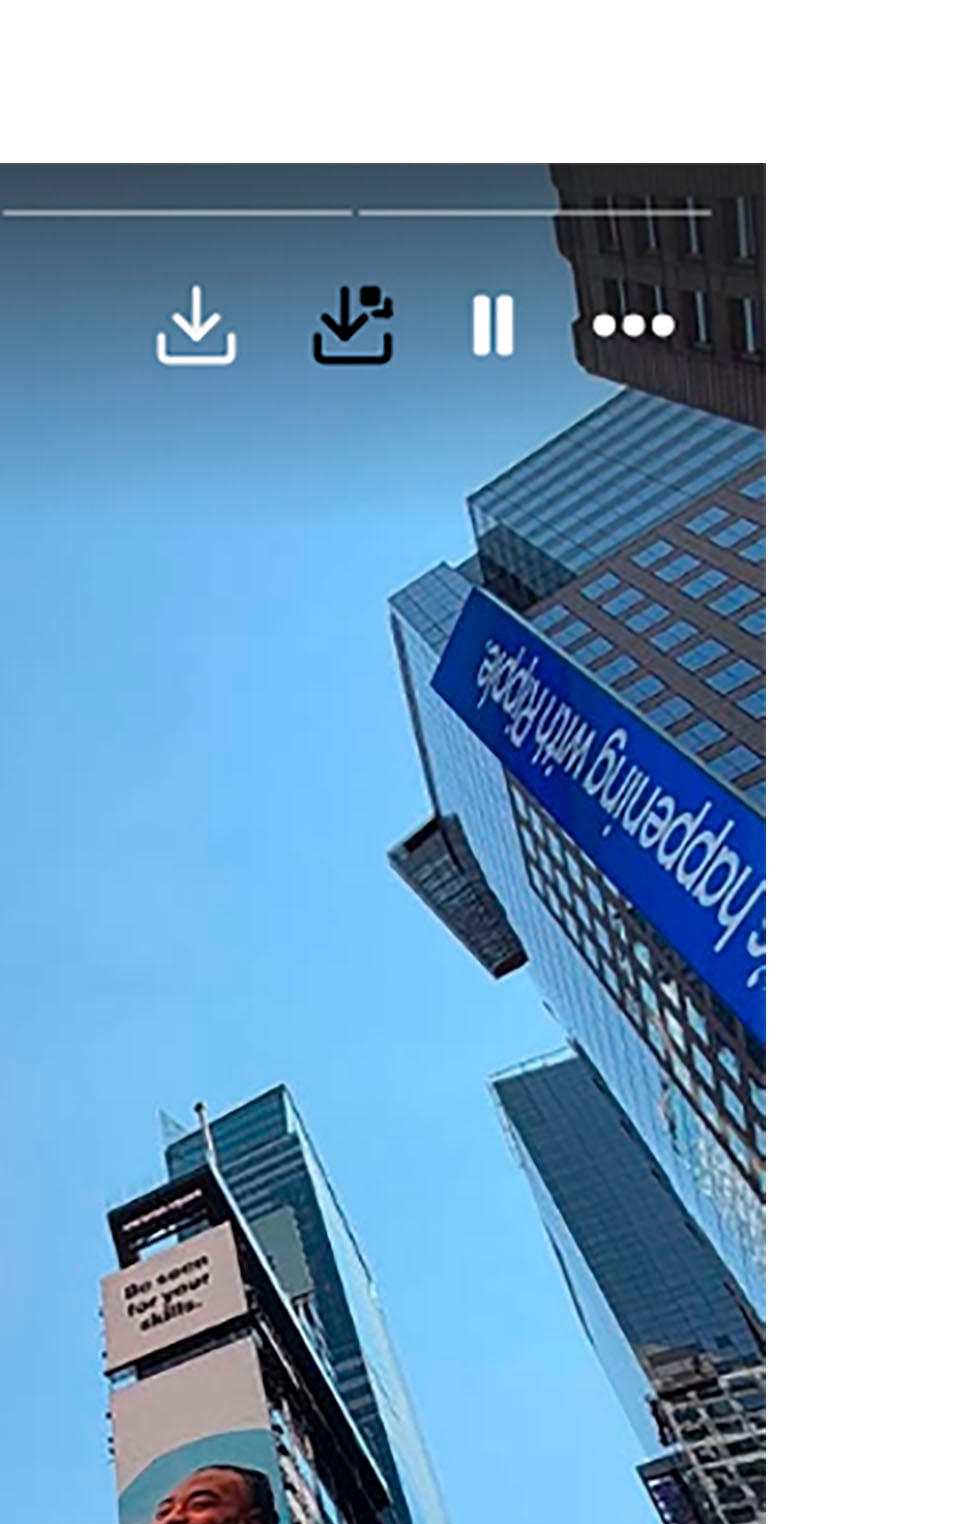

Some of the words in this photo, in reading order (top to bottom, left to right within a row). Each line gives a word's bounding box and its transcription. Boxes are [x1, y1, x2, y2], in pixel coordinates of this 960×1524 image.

[476, 639, 548, 750] Ripple.
[531, 698, 597, 780] with
[587, 728, 755, 954] happening
[127, 1295, 158, 1317] for
[160, 1273, 210, 1306] your
